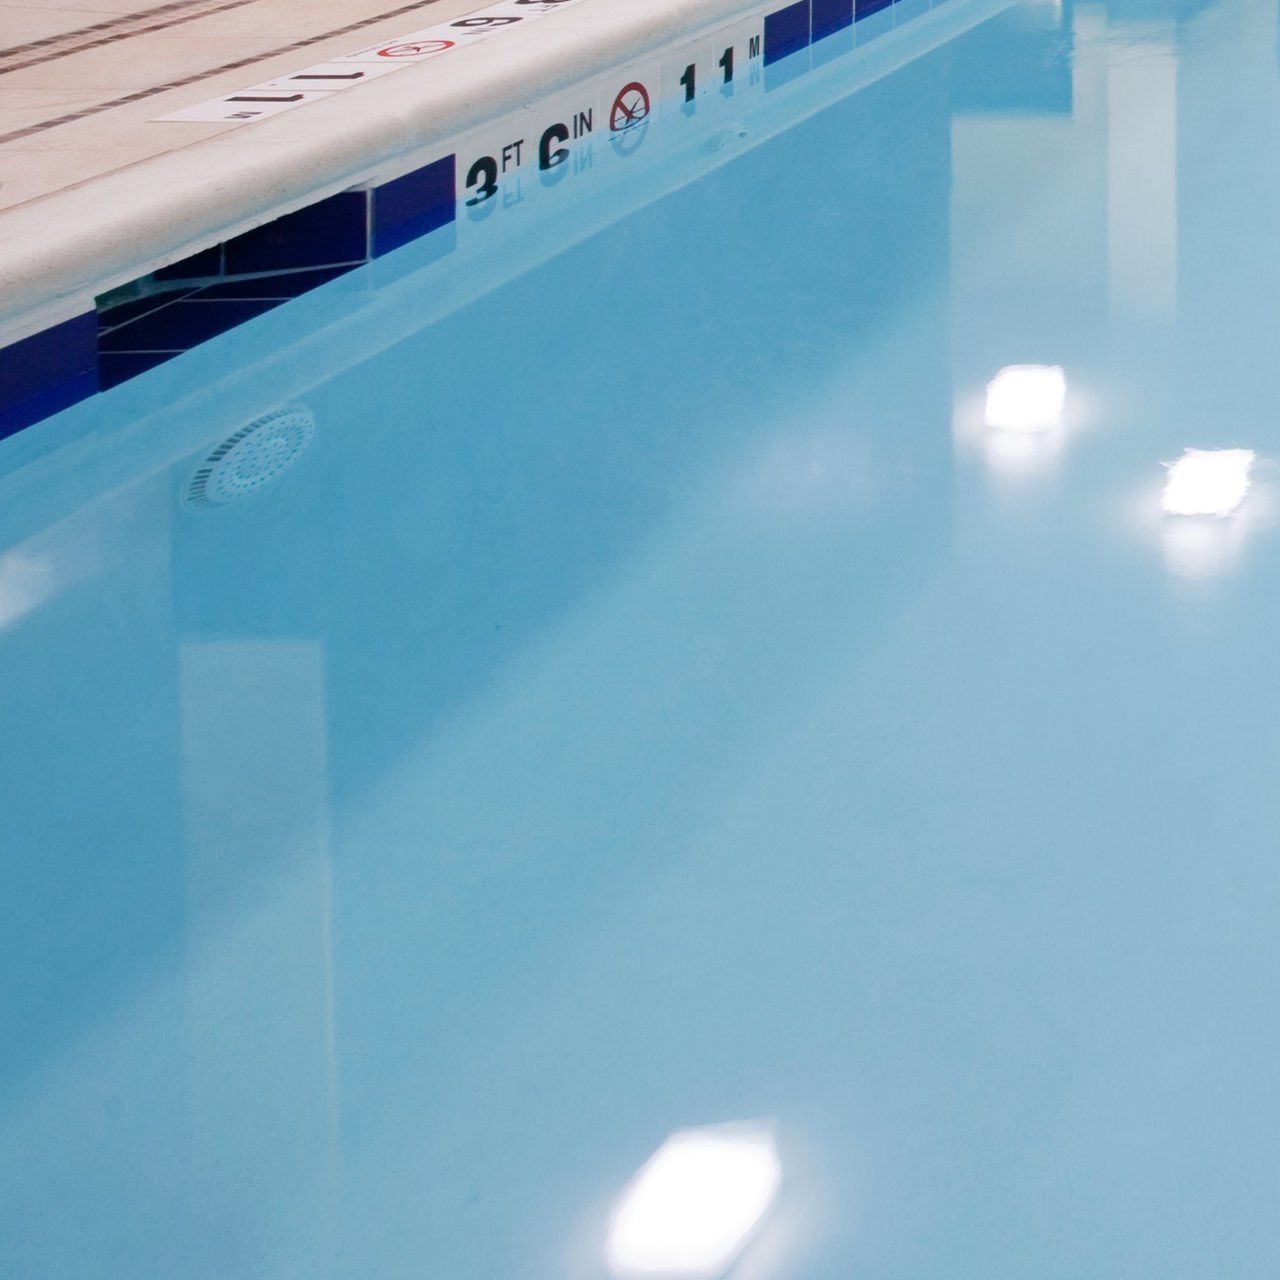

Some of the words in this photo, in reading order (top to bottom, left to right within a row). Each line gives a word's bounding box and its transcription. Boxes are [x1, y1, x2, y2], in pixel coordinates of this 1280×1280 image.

[465, 155, 498, 207] 3
[502, 139, 525, 174] FT
[538, 122, 570, 171] 6
[573, 108, 593, 140] IN
[749, 34, 760, 60] M
